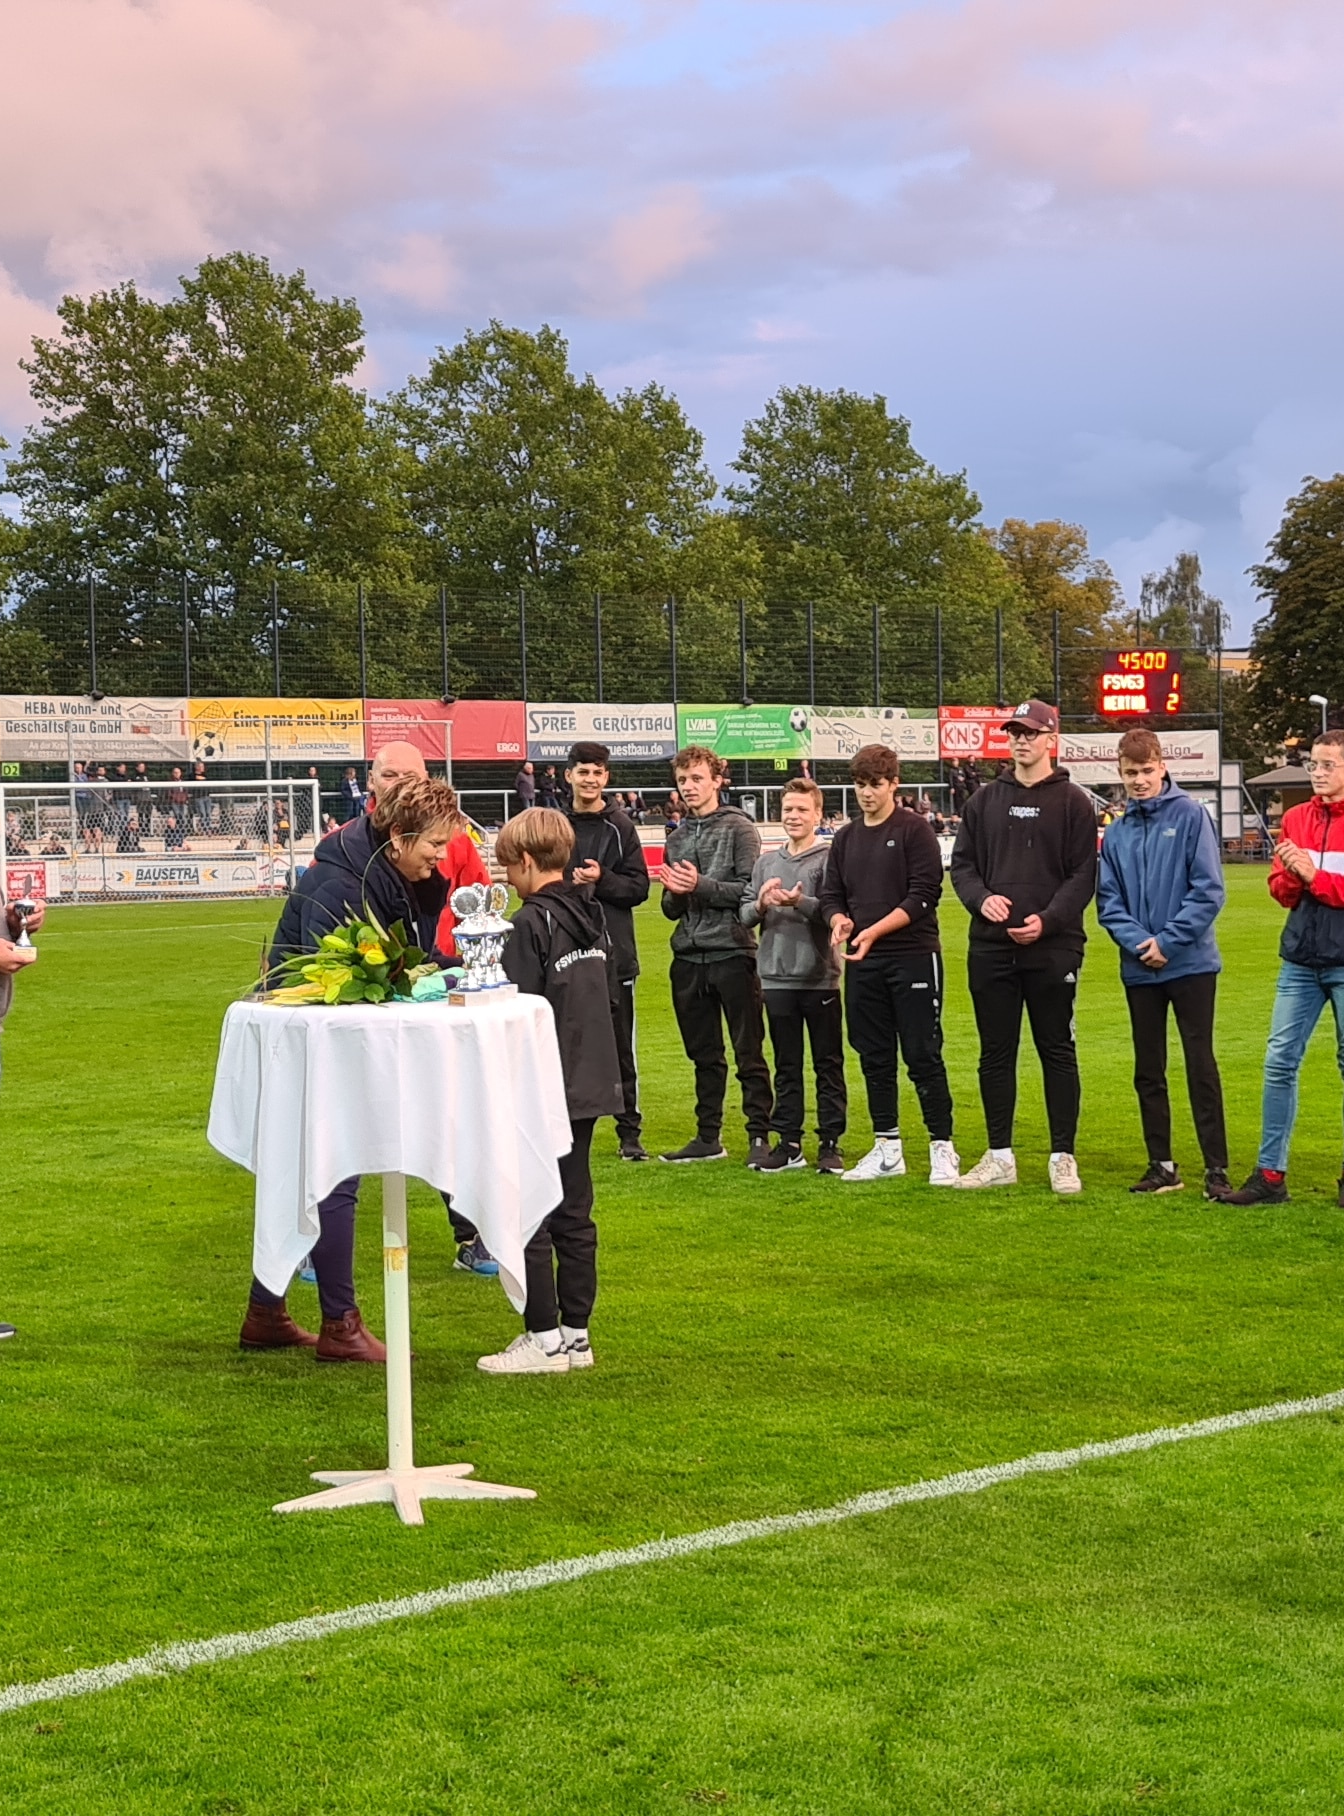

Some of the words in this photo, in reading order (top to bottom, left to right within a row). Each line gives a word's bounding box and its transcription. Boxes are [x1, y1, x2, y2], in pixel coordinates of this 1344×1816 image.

[1172, 673, 1179, 689] 1
[24, 702, 55, 715] HEBA
[60, 702, 97, 715] Wohn-
[101, 703, 122, 715] und
[1167, 693, 1180, 711] 2
[233, 710, 260, 728] Eine
[528, 711, 577, 734] SPREE
[592, 714, 673, 732] GERÜSTBAU
[89, 721, 122, 734] GmbH
[944, 727, 980, 745] KNS
[496, 743, 520, 753] ERGO
[1065, 746, 1085, 759] RS
[3, 765, 18, 776] D2
[554, 953, 573, 972] FSV
